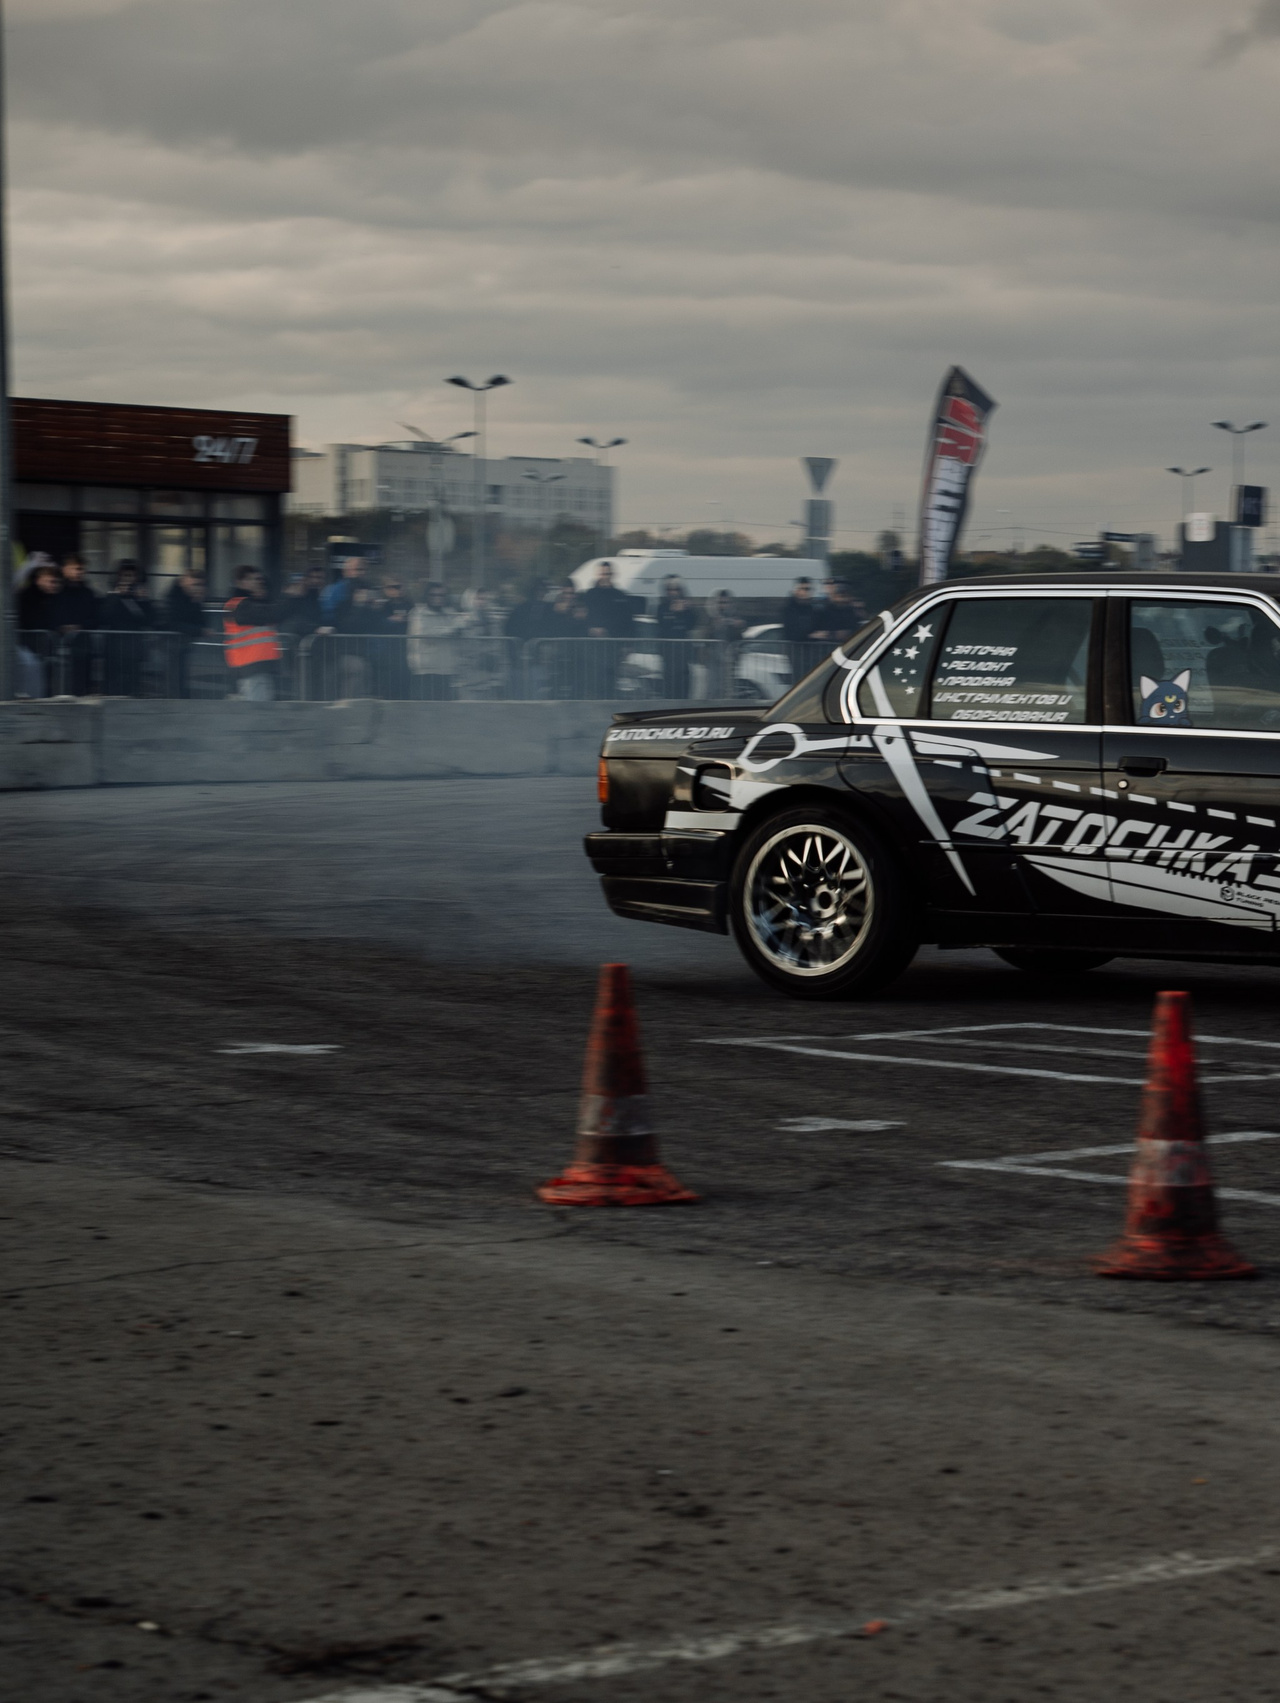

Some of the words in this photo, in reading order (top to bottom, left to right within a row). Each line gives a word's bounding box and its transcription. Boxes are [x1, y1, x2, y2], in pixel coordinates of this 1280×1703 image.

[191, 435, 259, 464] 24/7
[950, 644, 1018, 657] ЗАТОЧКА
[946, 660, 1014, 672] РЕМОНТ
[942, 676, 1017, 687] ПРОДАЖА
[932, 692, 1057, 705] ИНСТРУМЕНТОВ
[1056, 694, 1073, 705] И
[950, 709, 1070, 722] ОБОРУДОВАНИЯ
[605, 726, 736, 742] ZATOCHKA30.RU
